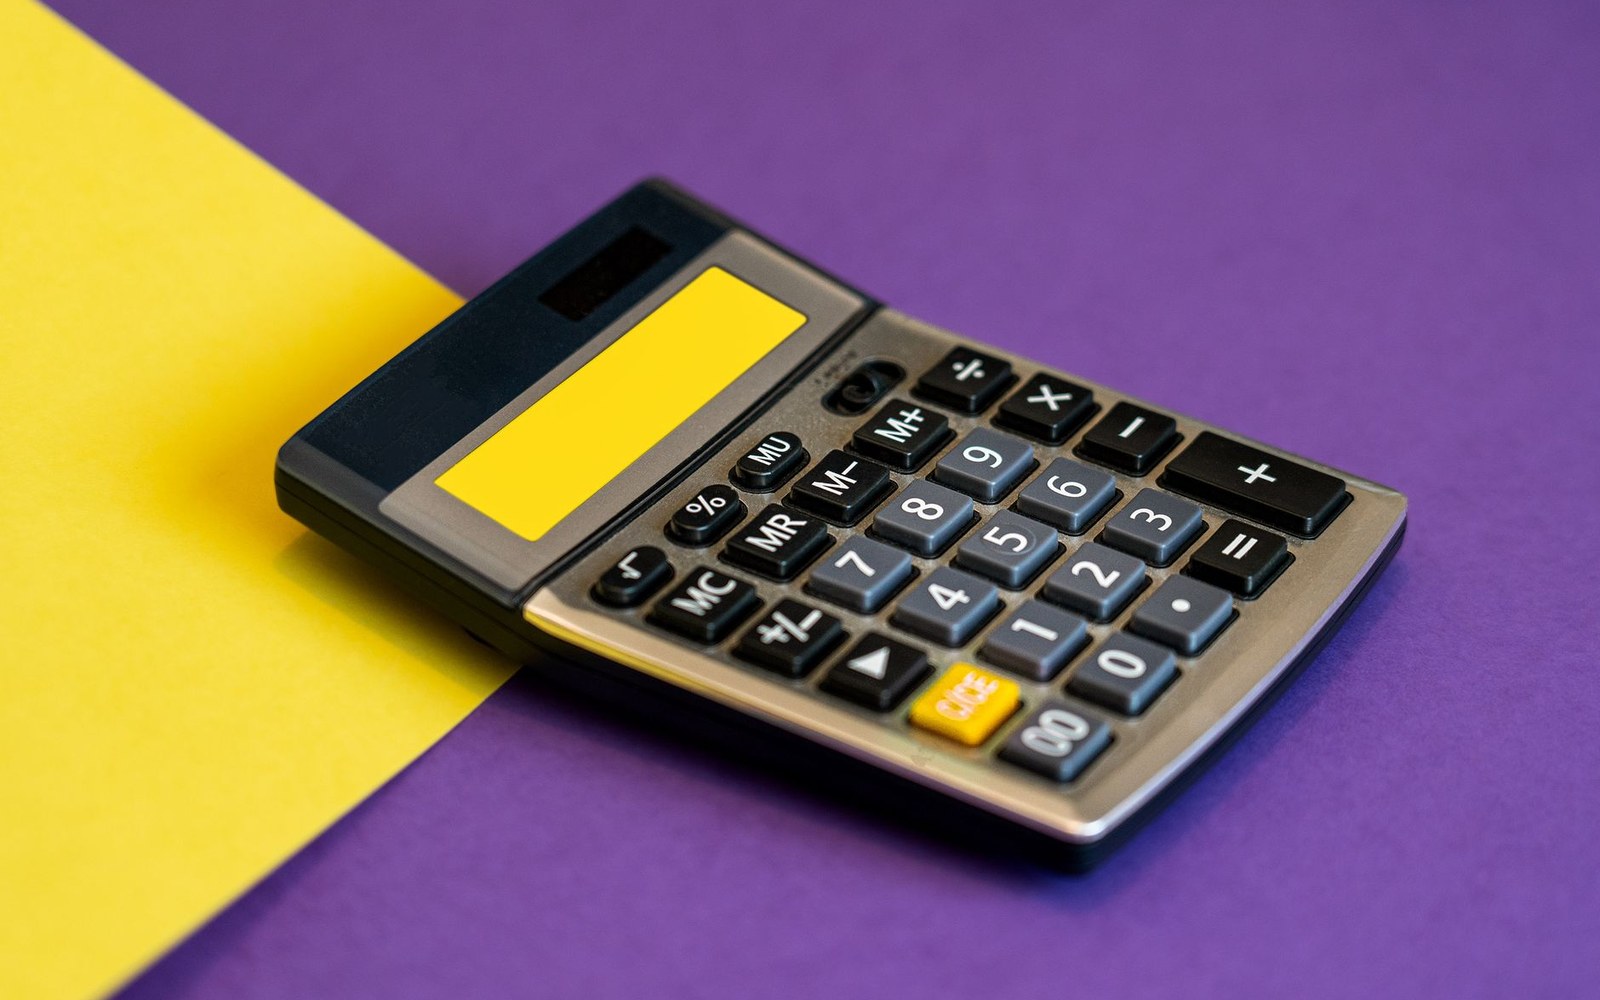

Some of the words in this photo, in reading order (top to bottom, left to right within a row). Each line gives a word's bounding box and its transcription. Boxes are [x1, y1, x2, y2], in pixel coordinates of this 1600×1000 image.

[873, 408, 924, 443] M+
[747, 436, 791, 466] MU
[962, 445, 1003, 469] 9
[1046, 475, 1088, 498] 6
[685, 494, 727, 516] %
[900, 497, 945, 521] 8
[745, 513, 808, 552] MR
[1129, 507, 1173, 532] 3
[982, 526, 1029, 553] 5
[834, 549, 876, 578] 7
[1071, 560, 1121, 589] 2
[673, 571, 736, 615] MC
[927, 583, 971, 611] 4
[1010, 617, 1059, 642] 1
[1097, 649, 1147, 679] 0
[1020, 709, 1090, 757] 00
